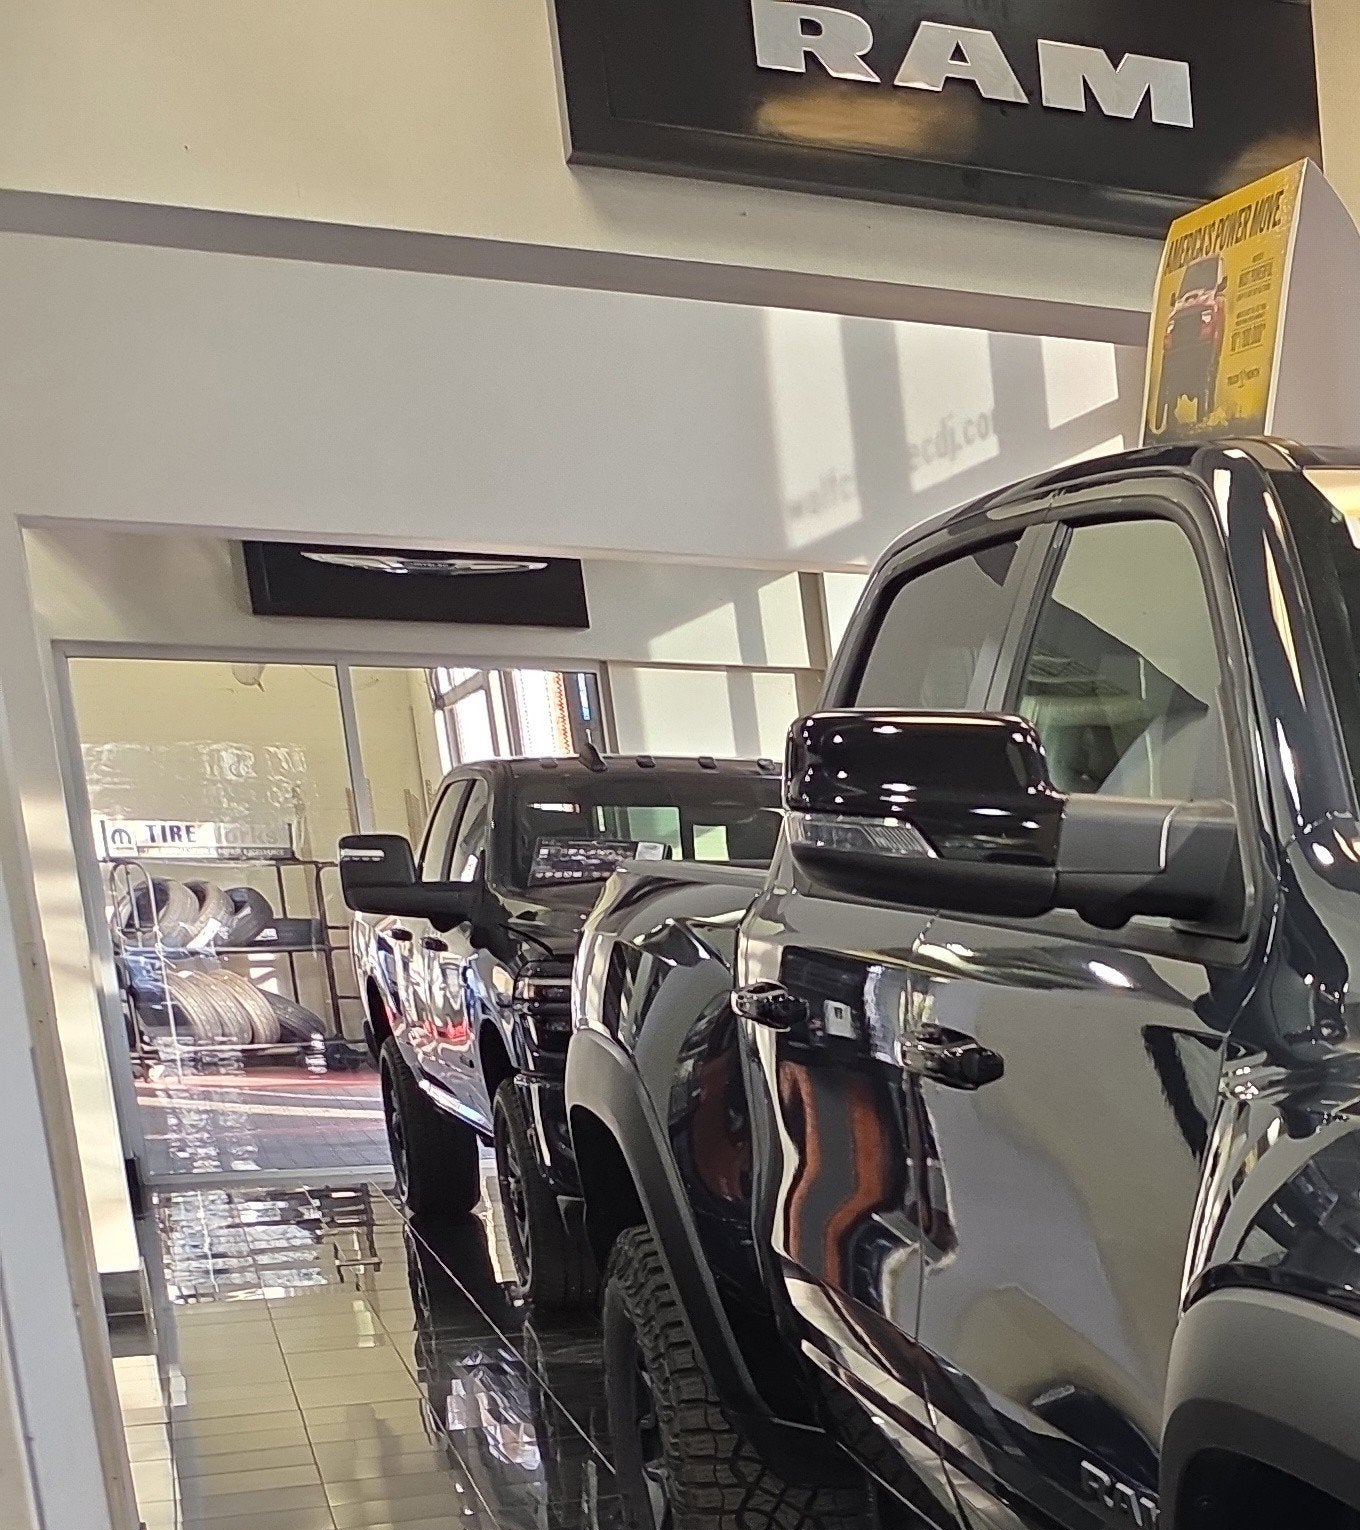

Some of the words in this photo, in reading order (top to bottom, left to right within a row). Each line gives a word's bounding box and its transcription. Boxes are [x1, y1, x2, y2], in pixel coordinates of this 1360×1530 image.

[751, 0, 1194, 128] RAM
[1212, 203, 1252, 252] POWER
[1249, 188, 1285, 238] MOVE
[145, 824, 198, 844] TIRE
